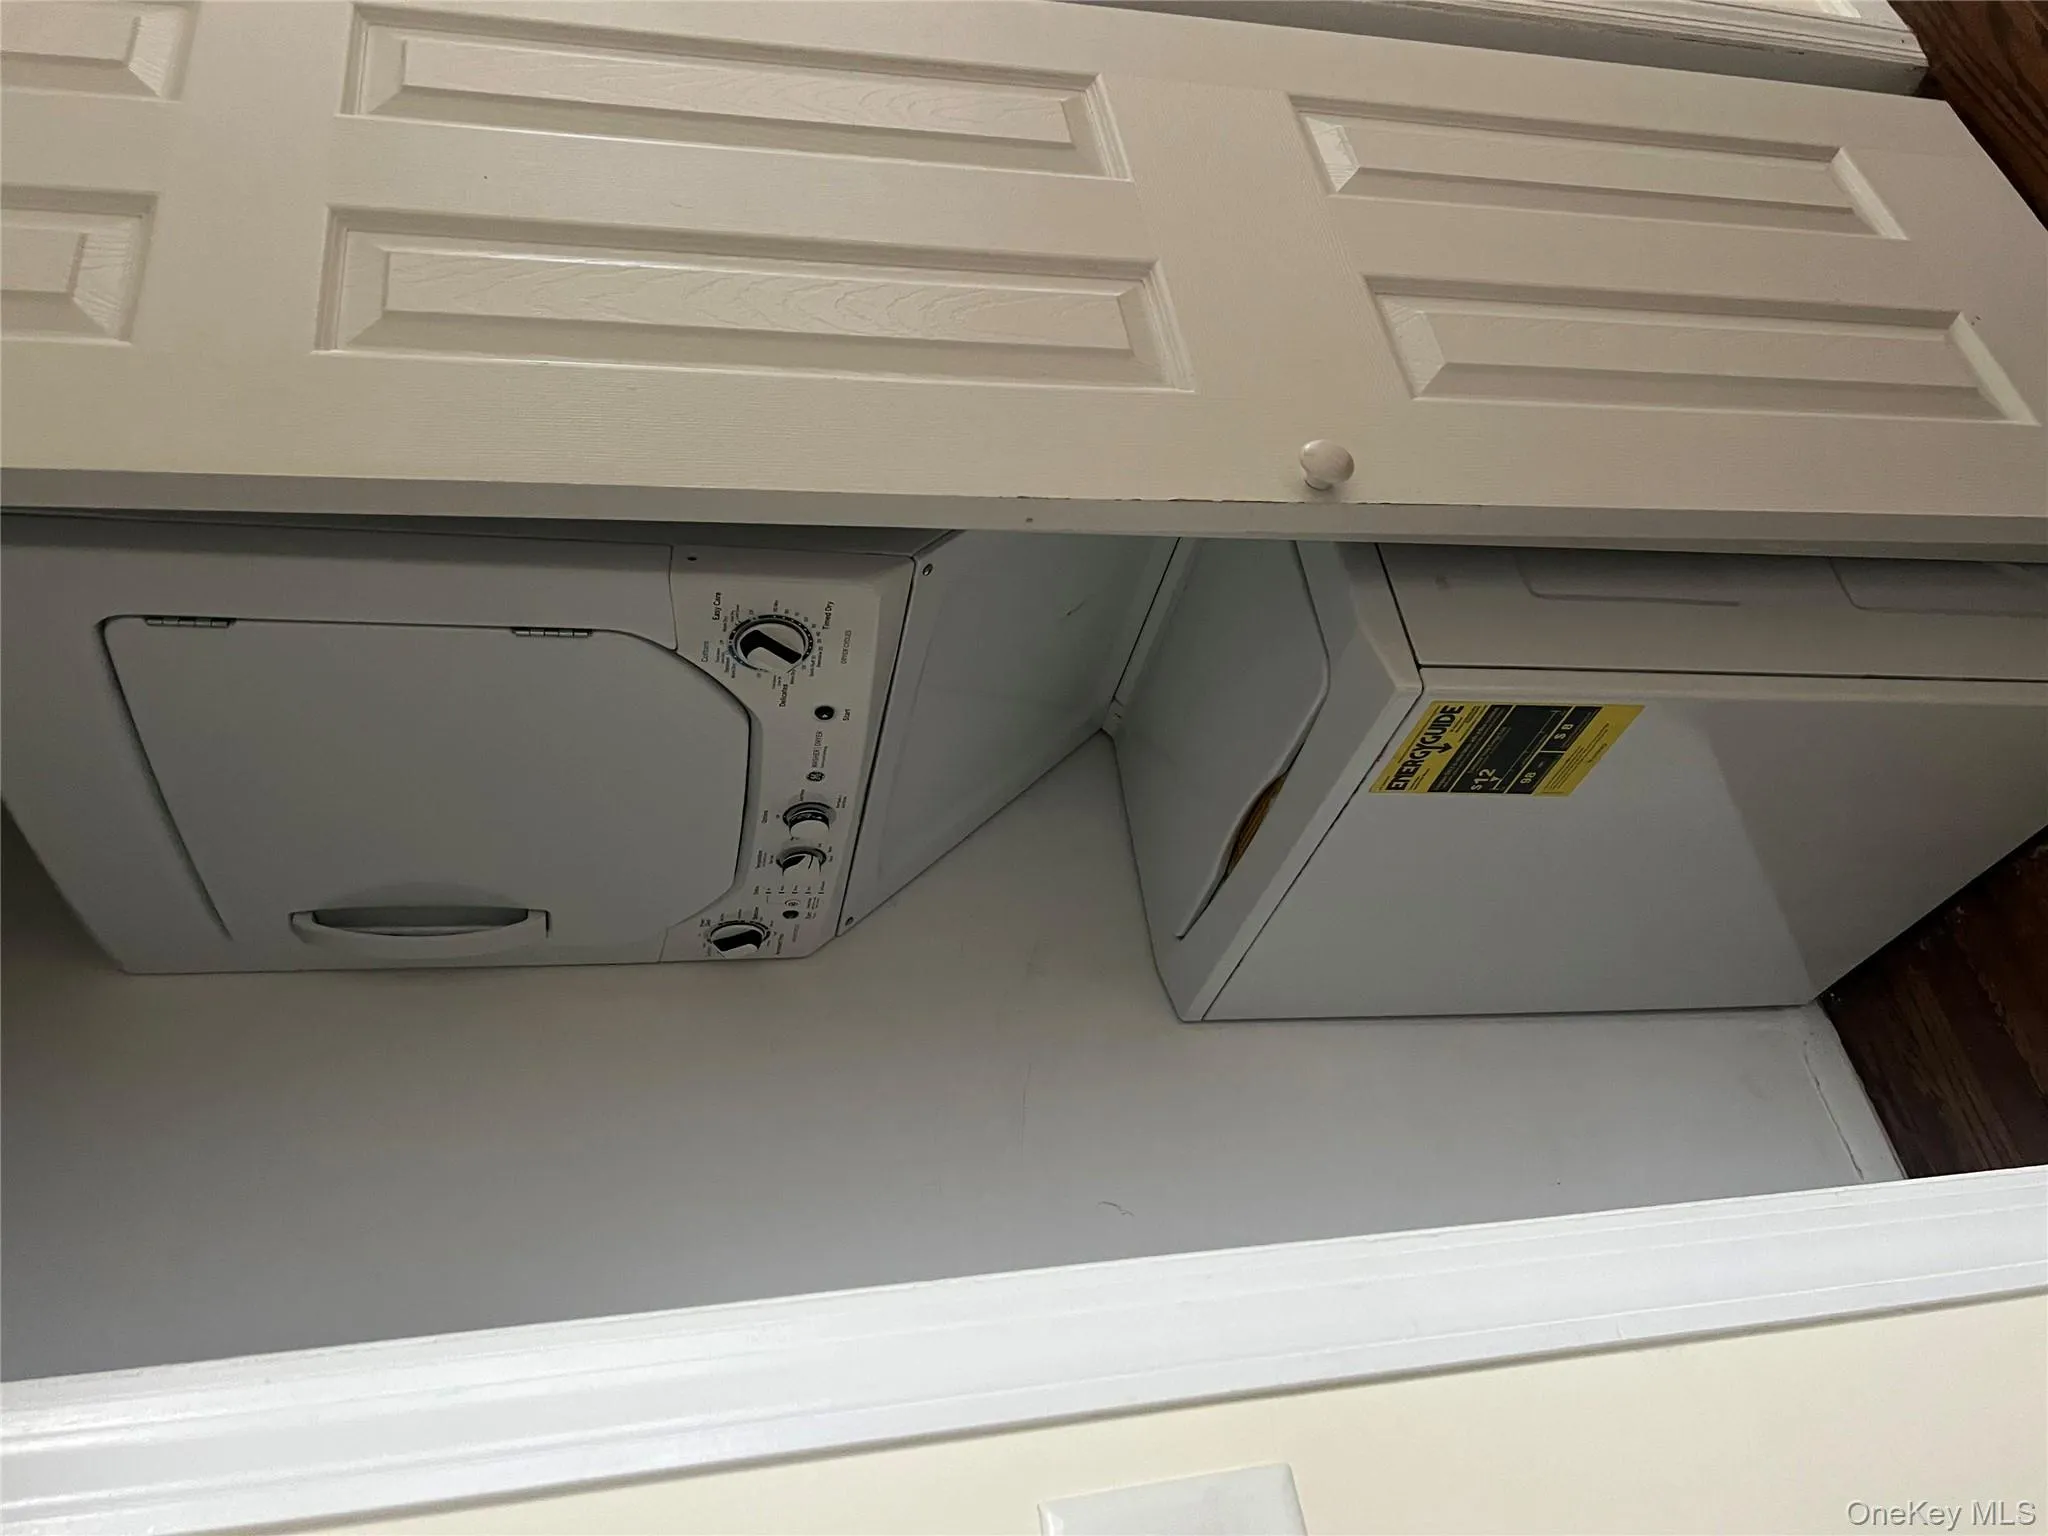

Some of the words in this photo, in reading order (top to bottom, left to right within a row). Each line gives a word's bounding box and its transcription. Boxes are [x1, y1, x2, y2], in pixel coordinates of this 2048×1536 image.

[713, 591, 722, 606] Care
[824, 600, 834, 612] Dry
[712, 607, 722, 621] Easy
[822, 612, 832, 630] Timed
[778, 684, 788, 707] Delicates
[1387, 704, 1465, 791] ENERGYGUIDE
[1470, 768, 1497, 791] $12
[1519, 771, 1537, 785] 98
